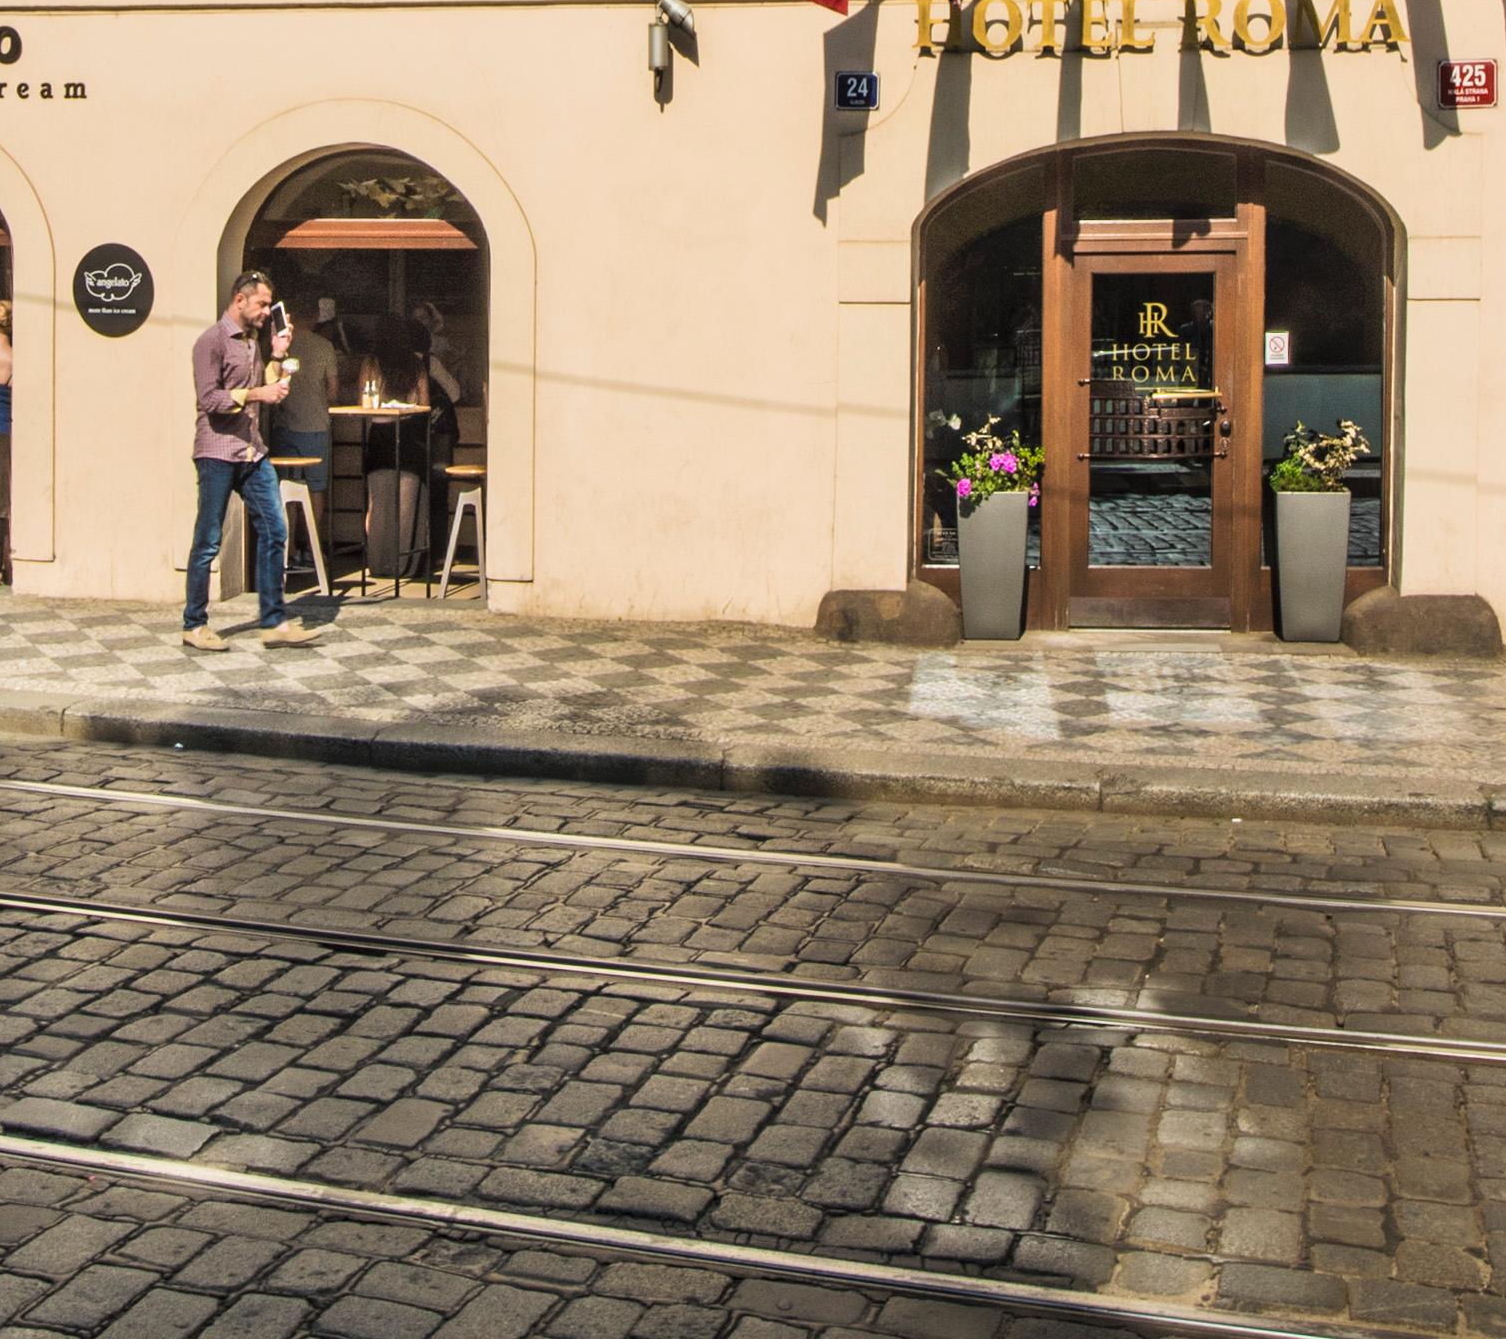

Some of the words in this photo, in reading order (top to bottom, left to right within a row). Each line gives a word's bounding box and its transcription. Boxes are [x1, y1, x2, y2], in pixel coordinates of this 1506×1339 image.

[1450, 64, 1486, 87] 425
[847, 77, 869, 98] 24
[96, 276, 130, 289] angelato
[1112, 343, 1197, 361] HOTEL
[1112, 365, 1197, 383] ROMA
